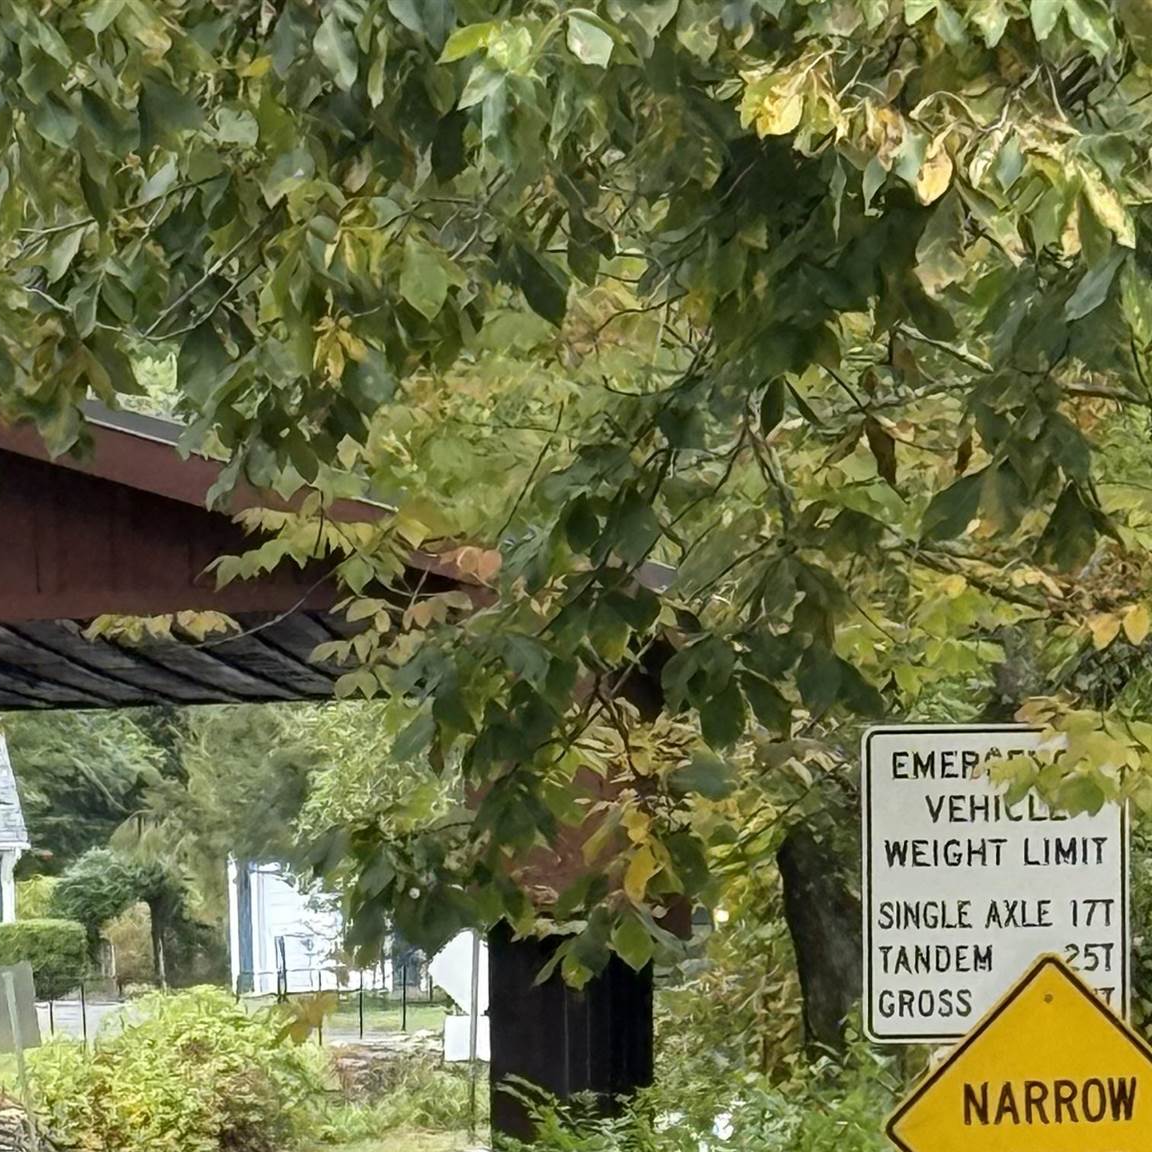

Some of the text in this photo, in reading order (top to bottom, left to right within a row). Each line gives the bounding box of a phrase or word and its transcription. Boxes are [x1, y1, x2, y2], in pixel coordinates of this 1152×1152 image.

[884, 836, 1108, 868] WEIGHT LIMIT
[877, 898, 1115, 929] SINGLE AXLE 17T
[878, 942, 1115, 975] TANDEM 25T
[878, 988, 973, 1018] GROSS
[963, 1076, 1137, 1126] NARROW
